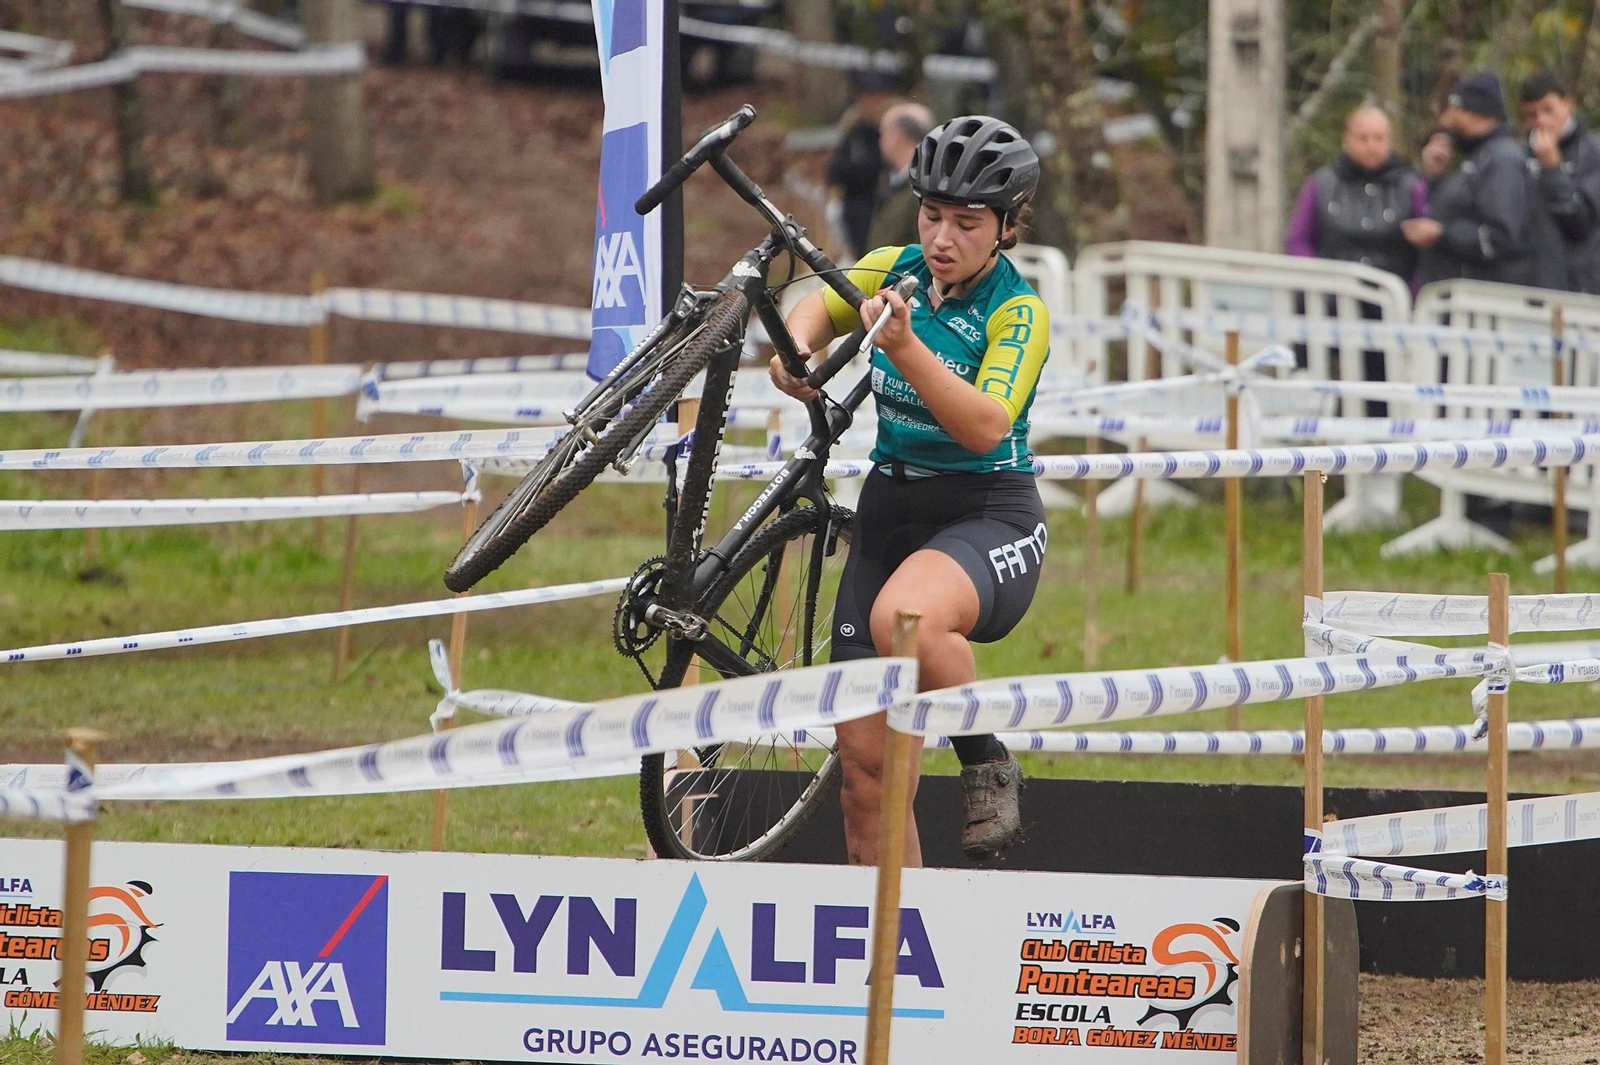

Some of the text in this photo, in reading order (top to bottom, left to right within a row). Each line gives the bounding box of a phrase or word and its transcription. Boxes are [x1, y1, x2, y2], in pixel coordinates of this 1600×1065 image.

[1026, 909, 1116, 934] LYNALFA
[0, 931, 110, 961] tears
[1021, 938, 1147, 965] Club Ciclista
[227, 960, 360, 1028] AXA
[1015, 964, 1196, 1000] Ponteareas
[4, 987, 67, 1008] GÓME
[1015, 1003, 1111, 1023] ESCOLA
[522, 1028, 858, 1064] GRUPO ASEGURADOR
[1012, 1026, 1082, 1047] BORJA
[1086, 1026, 1158, 1049] GÓMEZ
